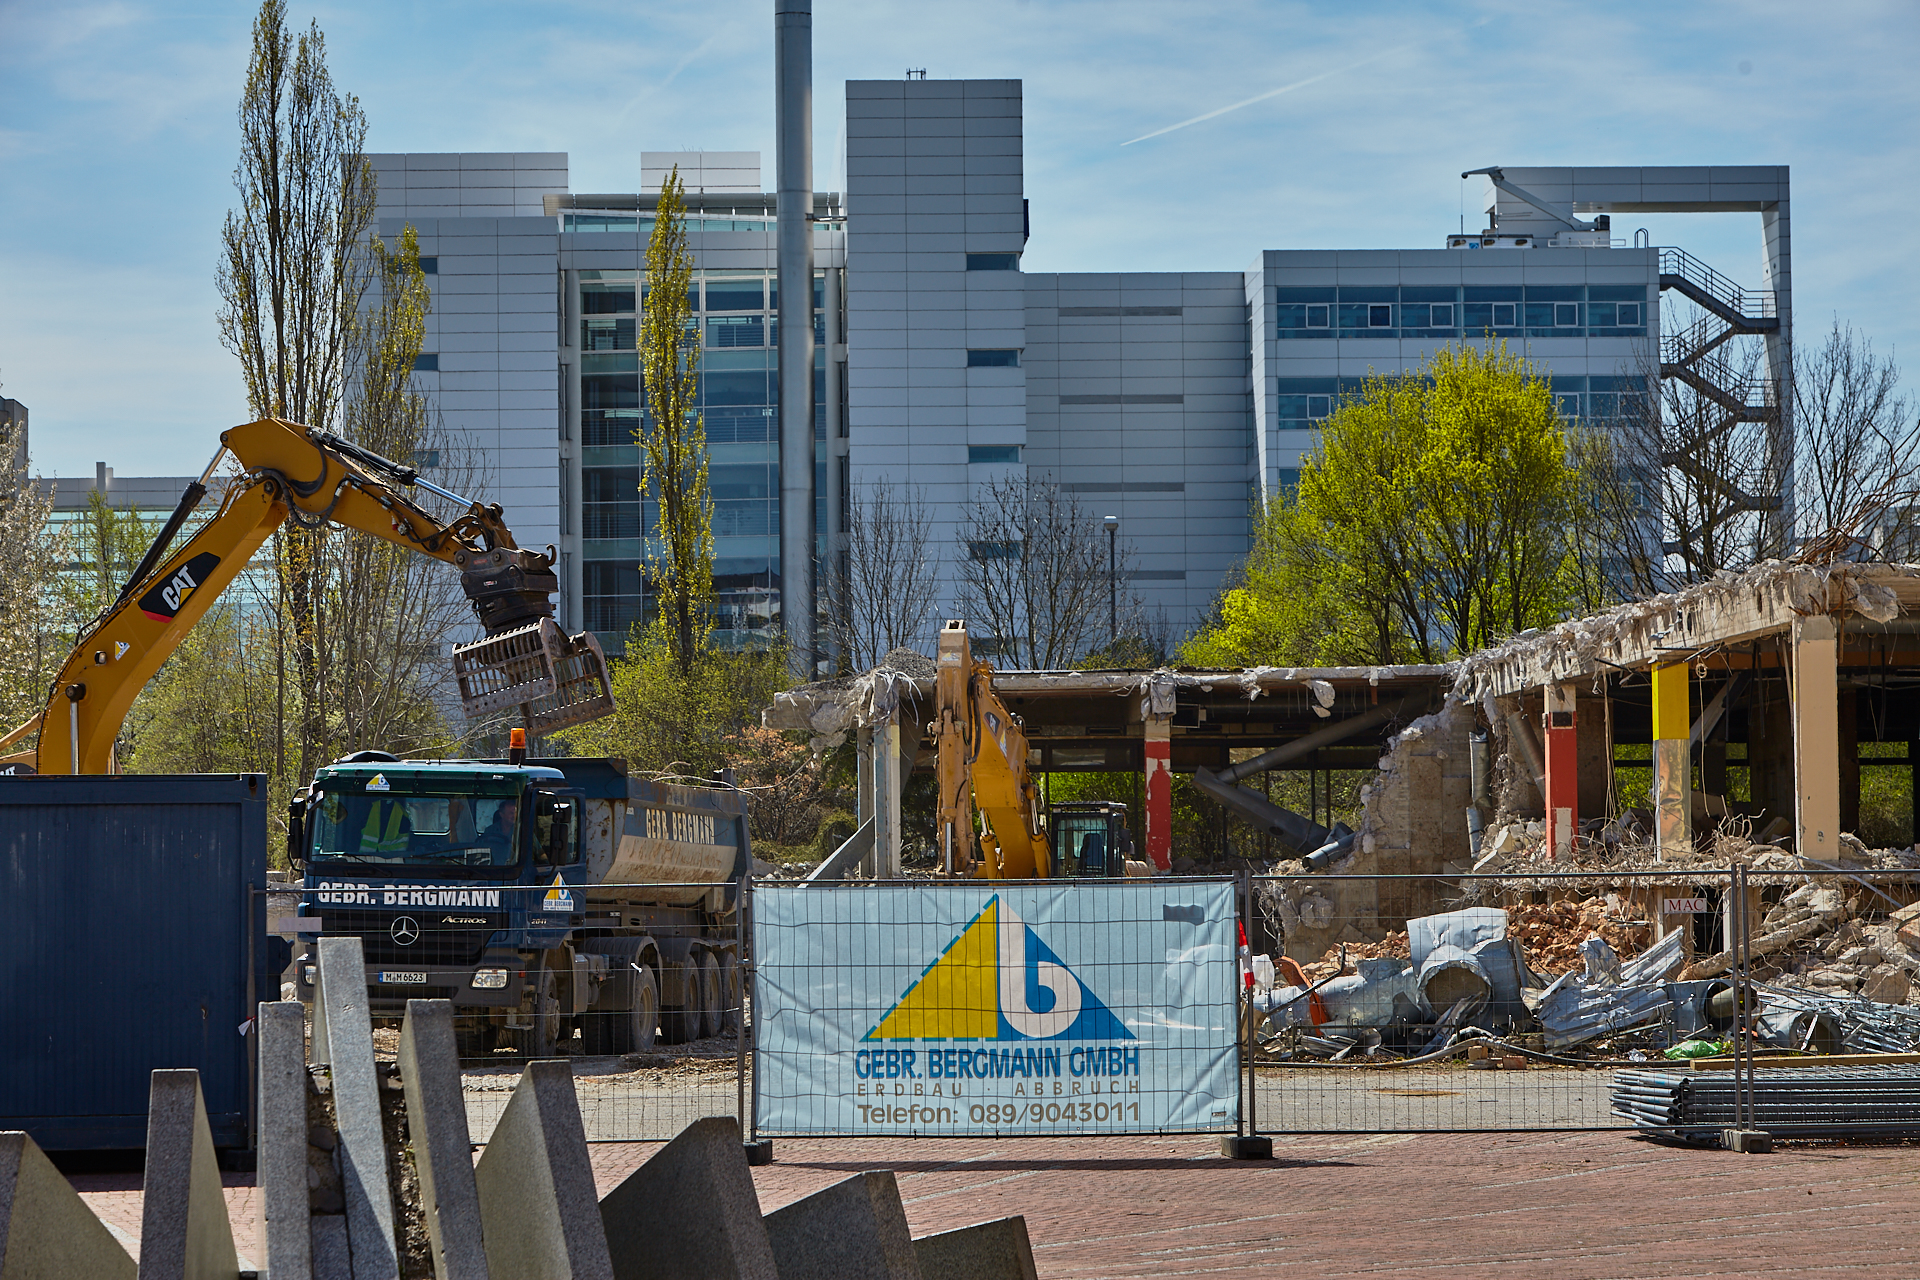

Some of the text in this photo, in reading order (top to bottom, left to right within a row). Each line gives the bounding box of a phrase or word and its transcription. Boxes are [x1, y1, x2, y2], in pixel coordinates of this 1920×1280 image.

[161, 564, 198, 611] CAT
[672, 811, 715, 845] BERGMANN
[317, 881, 500, 908] GEBR. BERGMANN
[1668, 899, 1704, 911] MAC
[855, 1046, 1139, 1079] GEBR. BERGMANN GMBH
[857, 1080, 1139, 1097] ERDBAU ABBRUCH
[857, 1101, 1139, 1125] Telefon: 089/9043011
